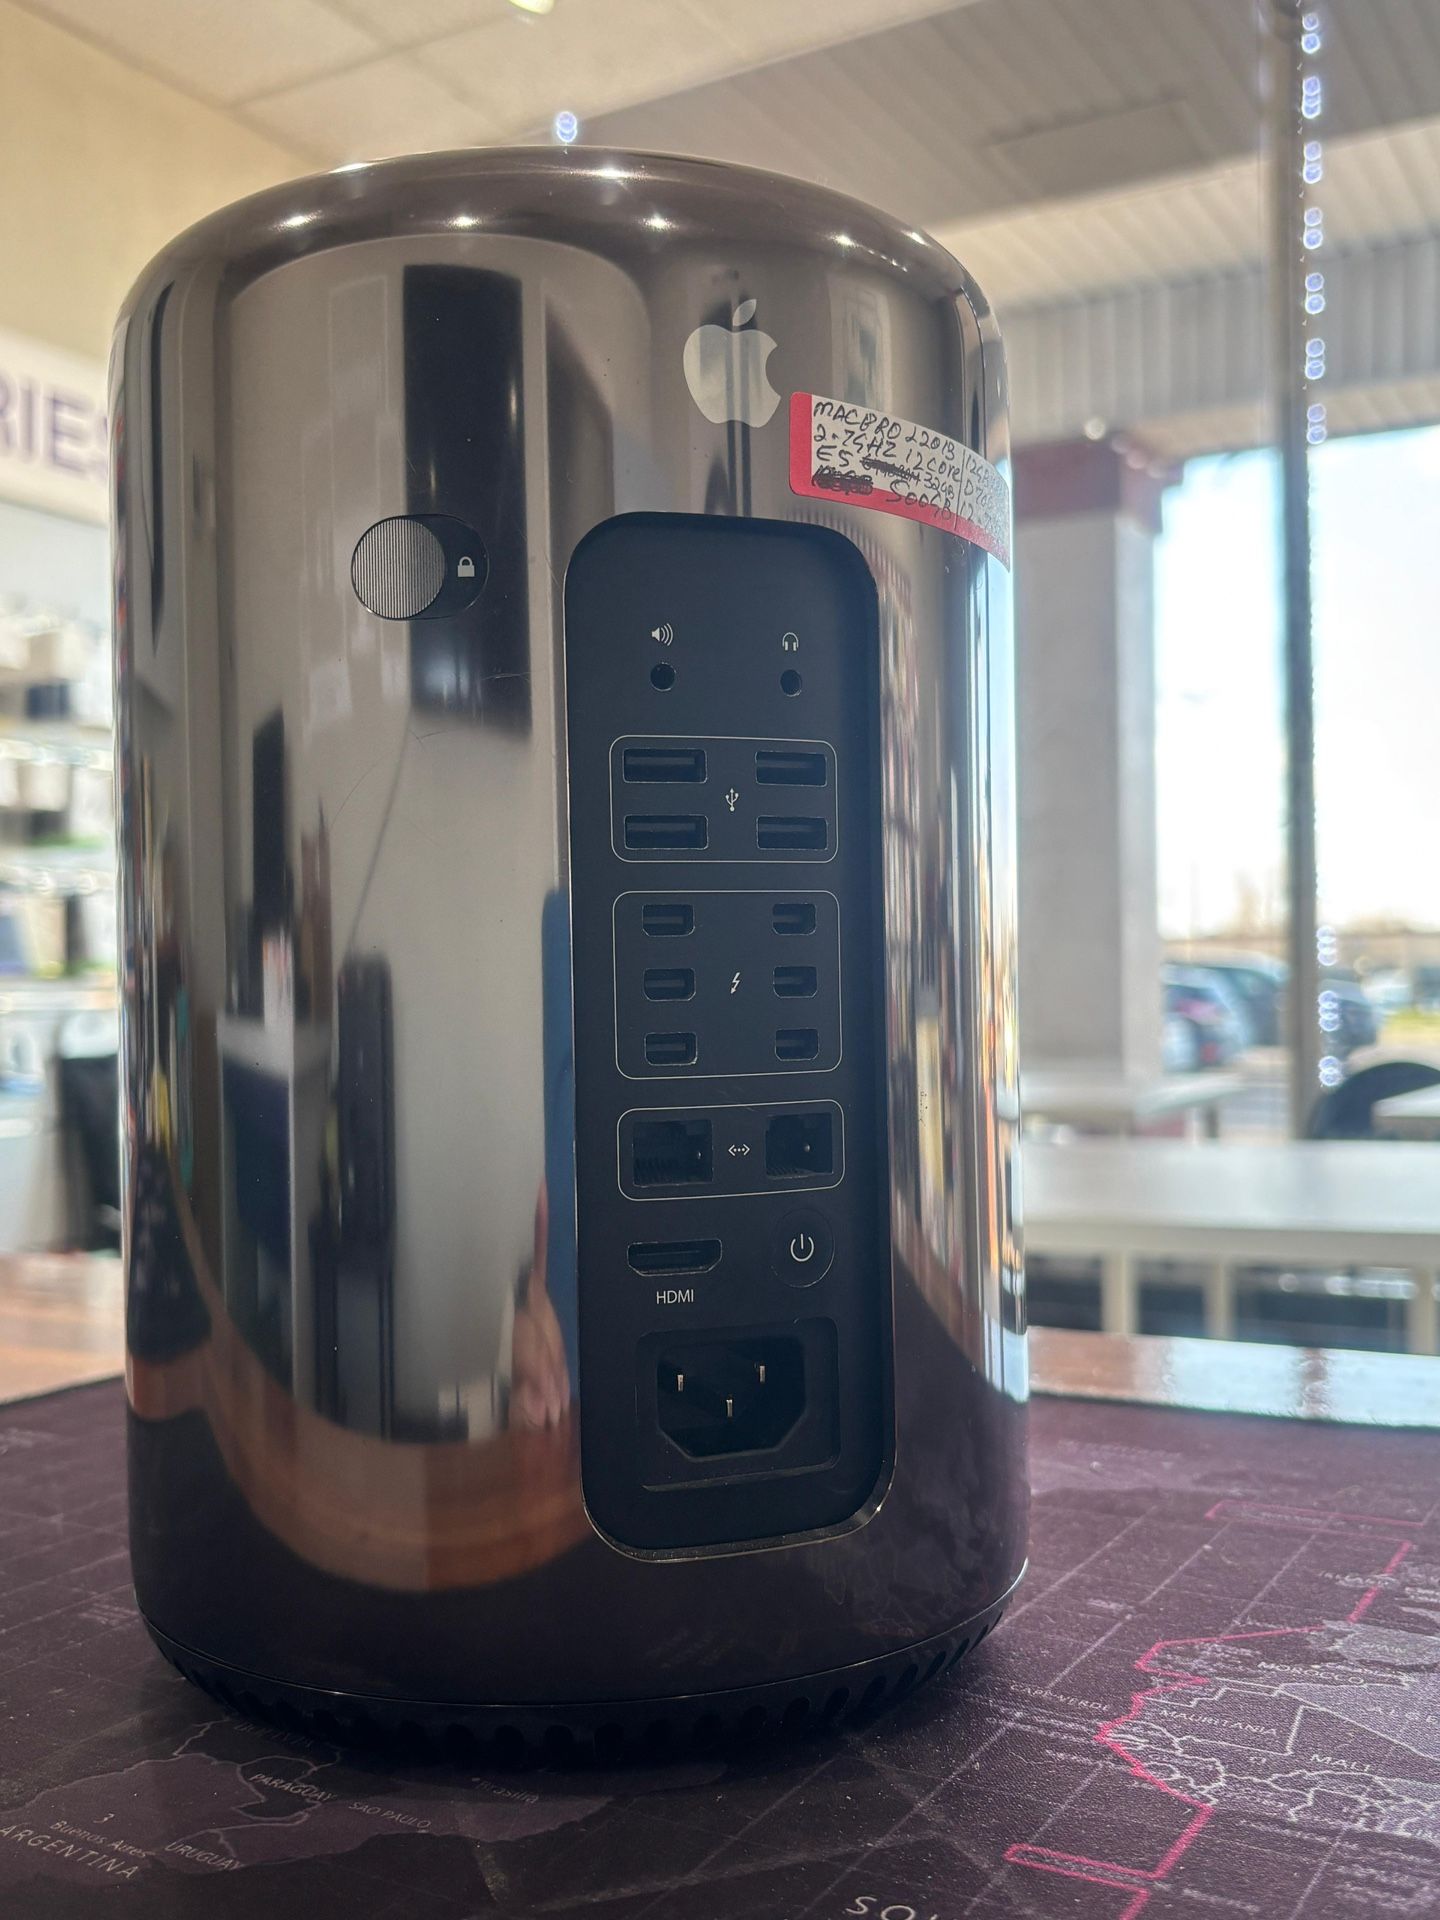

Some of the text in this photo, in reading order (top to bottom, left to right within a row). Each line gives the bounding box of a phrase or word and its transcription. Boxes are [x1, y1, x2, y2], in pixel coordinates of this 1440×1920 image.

[0, 372, 108, 486] RIE
[656, 1289, 694, 1304] HDMI
[1257, 1661, 1365, 1685] MOROCCO
[1158, 1707, 1278, 1737] MAURITANIA
[1309, 1753, 1371, 1772] MALI
[248, 1772, 336, 1802] PARAGUAY
[382, 1808, 432, 1829] PAULO
[0, 1824, 139, 1879] ARGENTINA
[50, 1820, 148, 1859] Buenos Aires
[164, 1840, 243, 1870] URUGUAY
[845, 1896, 938, 1920] SO
